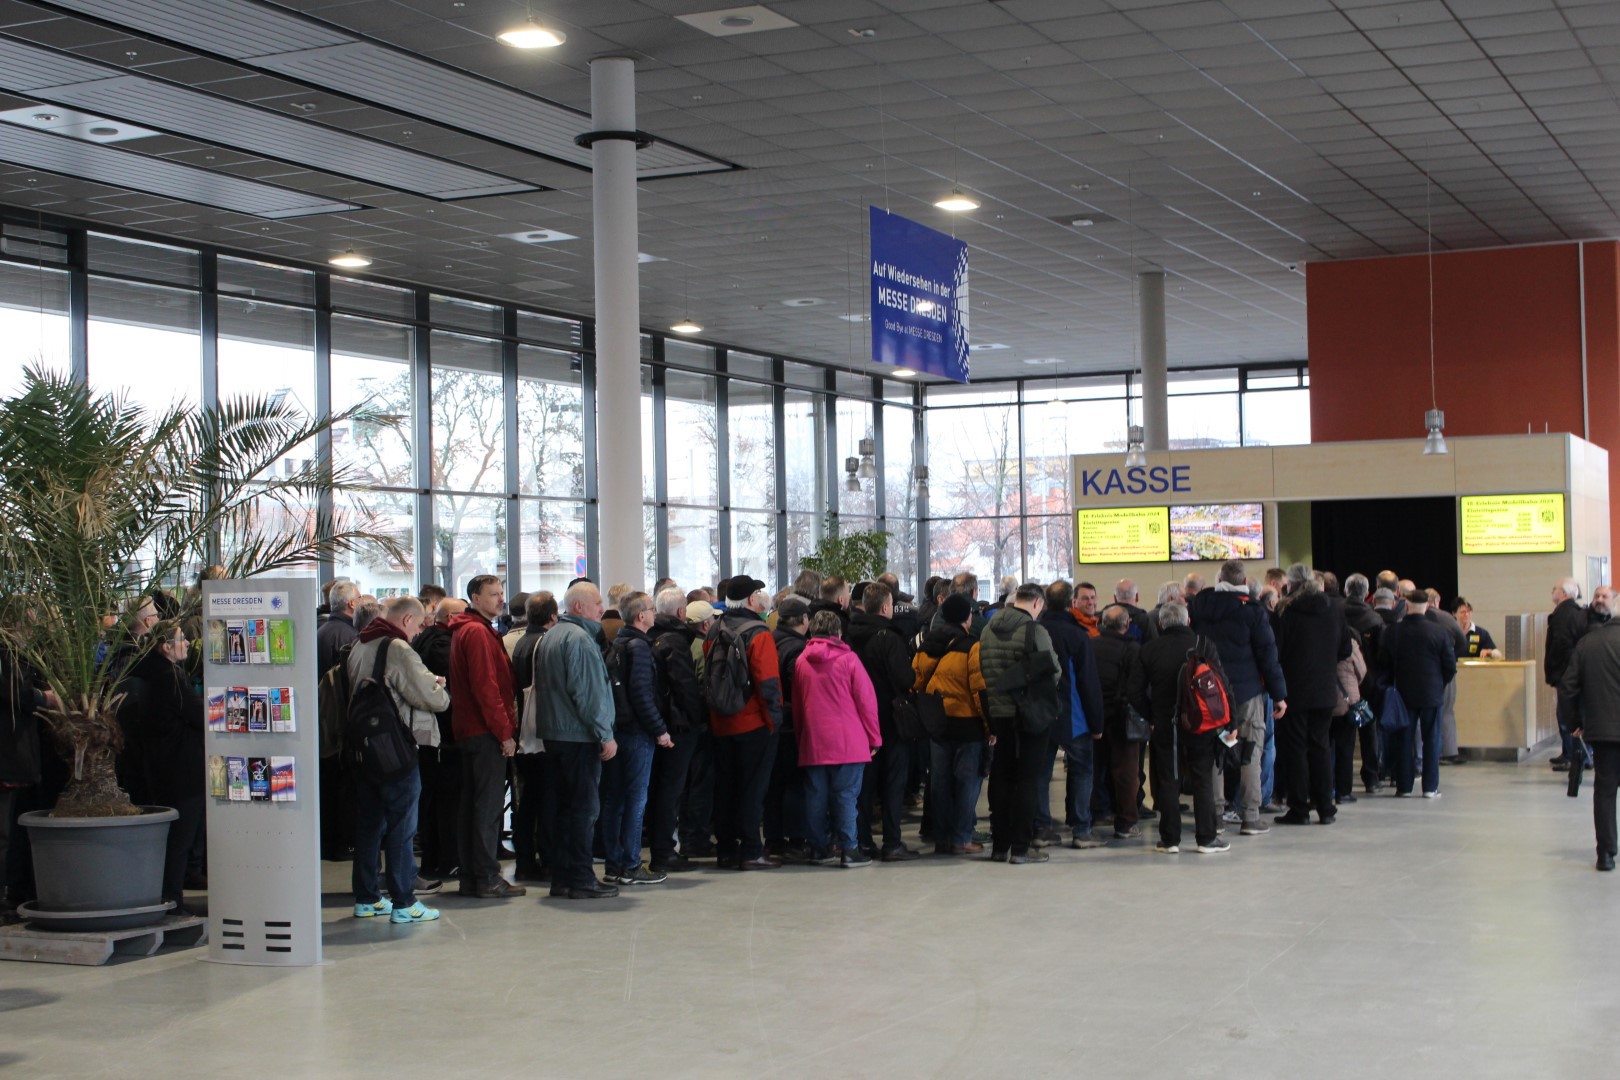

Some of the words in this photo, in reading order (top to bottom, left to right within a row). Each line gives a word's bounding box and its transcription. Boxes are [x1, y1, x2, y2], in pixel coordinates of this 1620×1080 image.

[873, 260, 887, 278] Auf
[888, 264, 932, 293] Wiedersehen
[933, 279, 940, 295] in
[940, 282, 951, 299] der
[878, 286, 908, 312] MESSE
[910, 296, 947, 323] DRESDEN
[884, 318, 896, 331] Good
[896, 322, 904, 335] Bye
[908, 325, 923, 339] MESSE
[923, 329, 943, 344] DRESDEN
[1082, 465, 1192, 496] KASSE
[232, 597, 263, 605] DRESDEN
